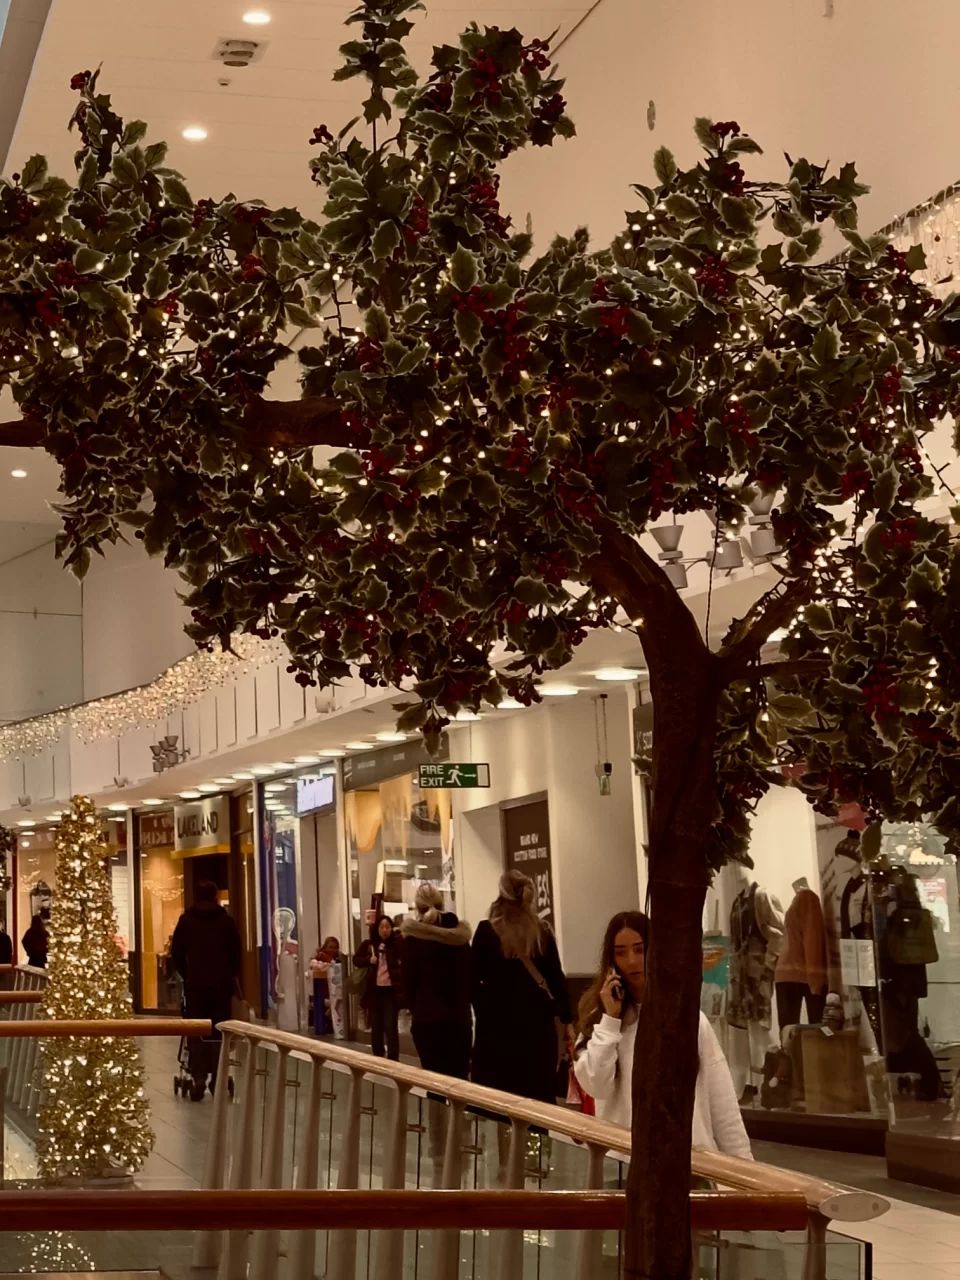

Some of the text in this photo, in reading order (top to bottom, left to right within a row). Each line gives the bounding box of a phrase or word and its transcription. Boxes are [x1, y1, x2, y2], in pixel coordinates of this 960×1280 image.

[420, 765, 444, 775] FIRE
[420, 777, 444, 787] EXIT
[177, 811, 219, 839] LAKELAND
